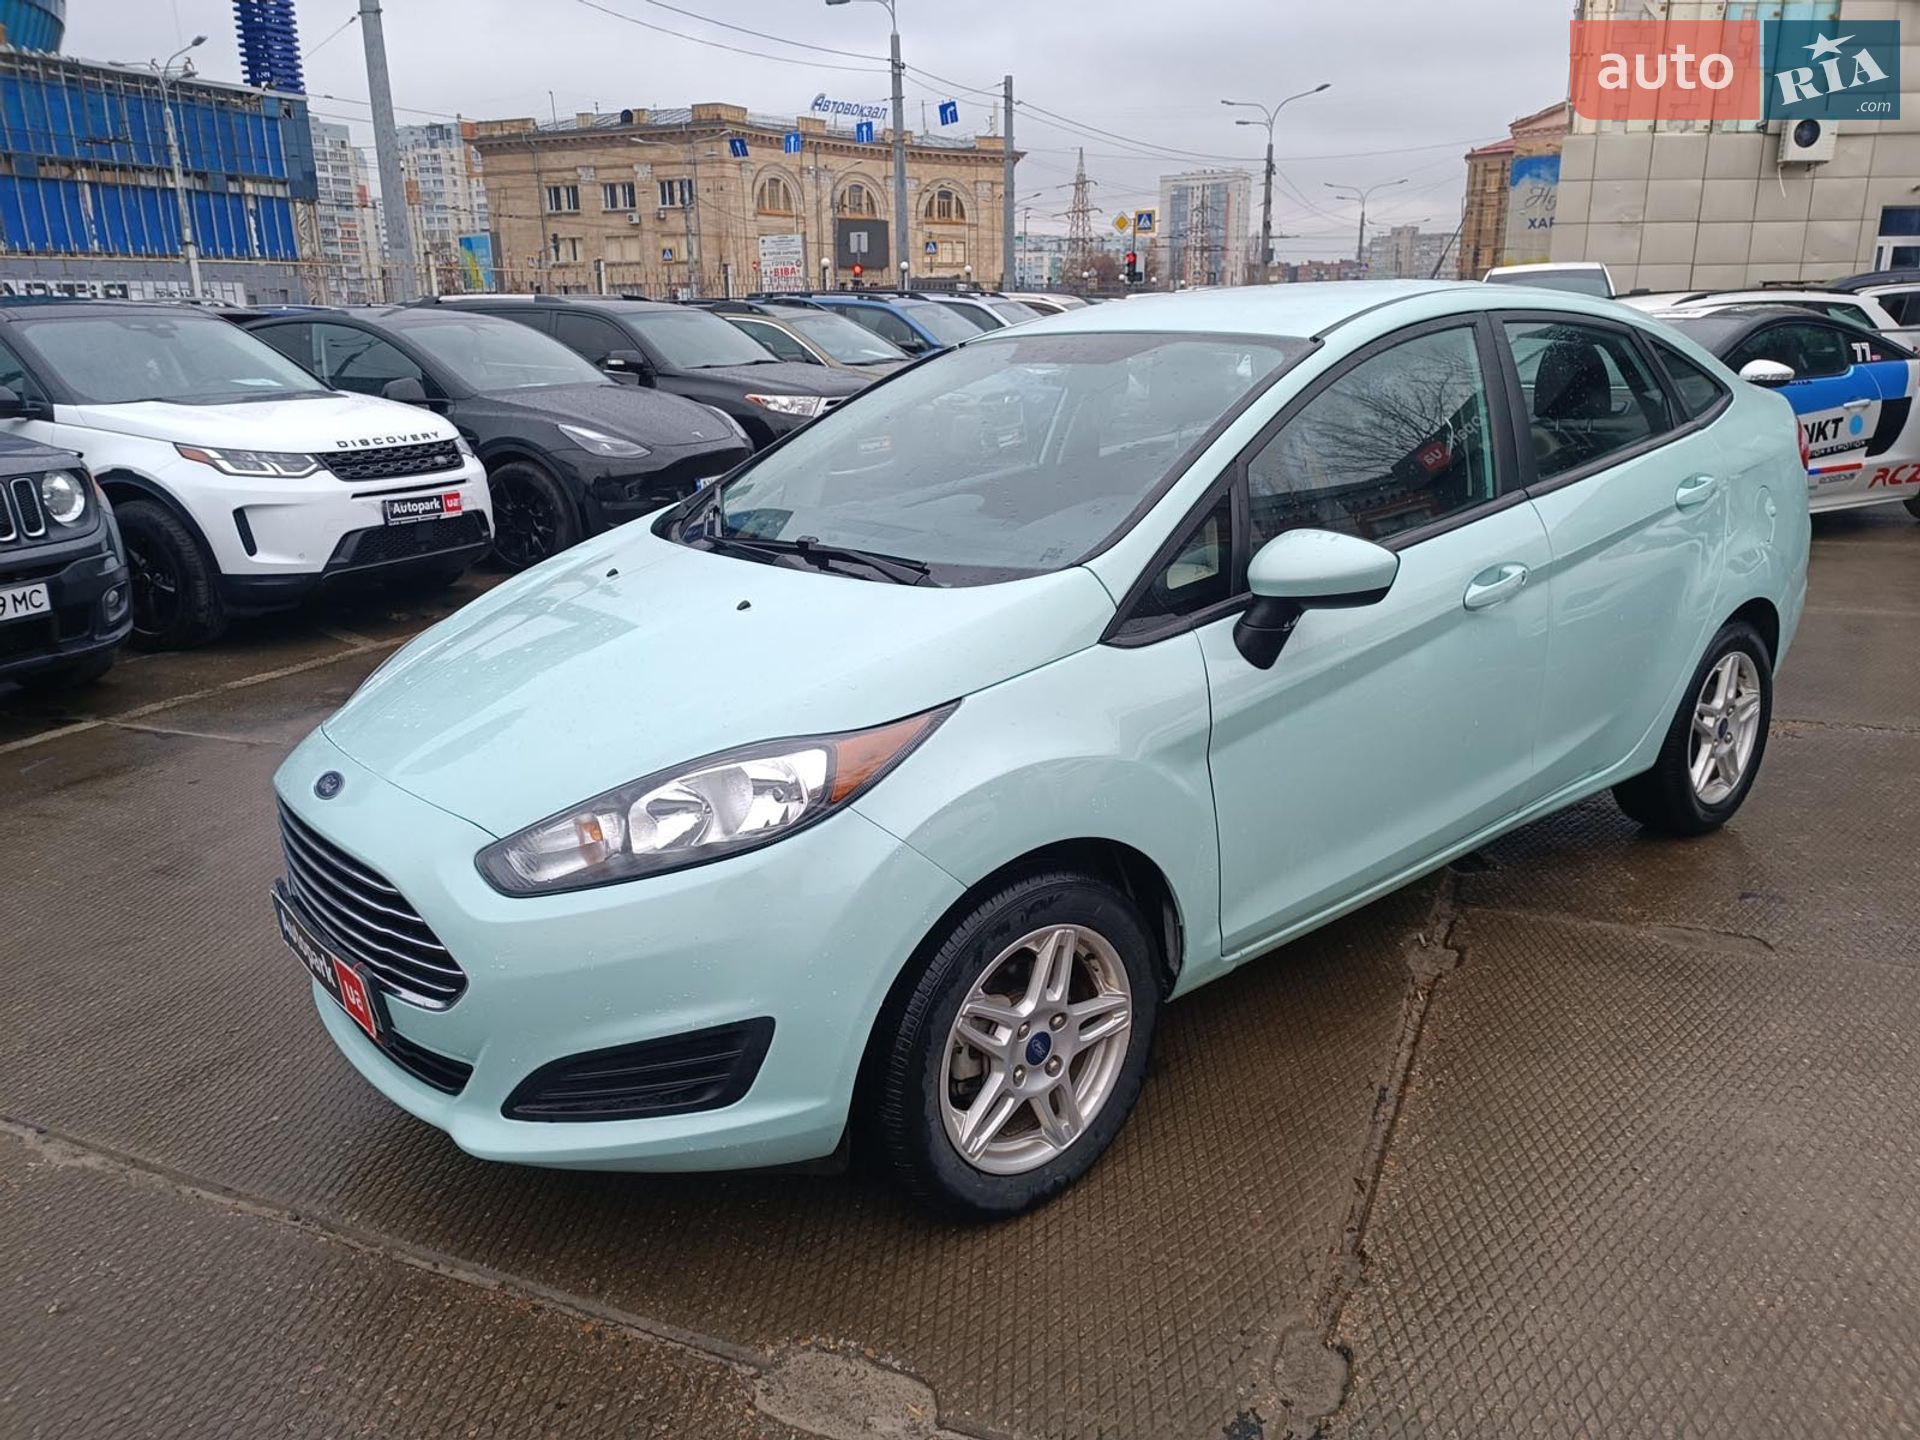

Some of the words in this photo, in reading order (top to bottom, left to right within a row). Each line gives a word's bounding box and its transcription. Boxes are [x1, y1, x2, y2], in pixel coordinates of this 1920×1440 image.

[336, 431, 440, 448] DISCOVERY
[392, 498, 441, 515] Autopark
[446, 498, 460, 508] ua
